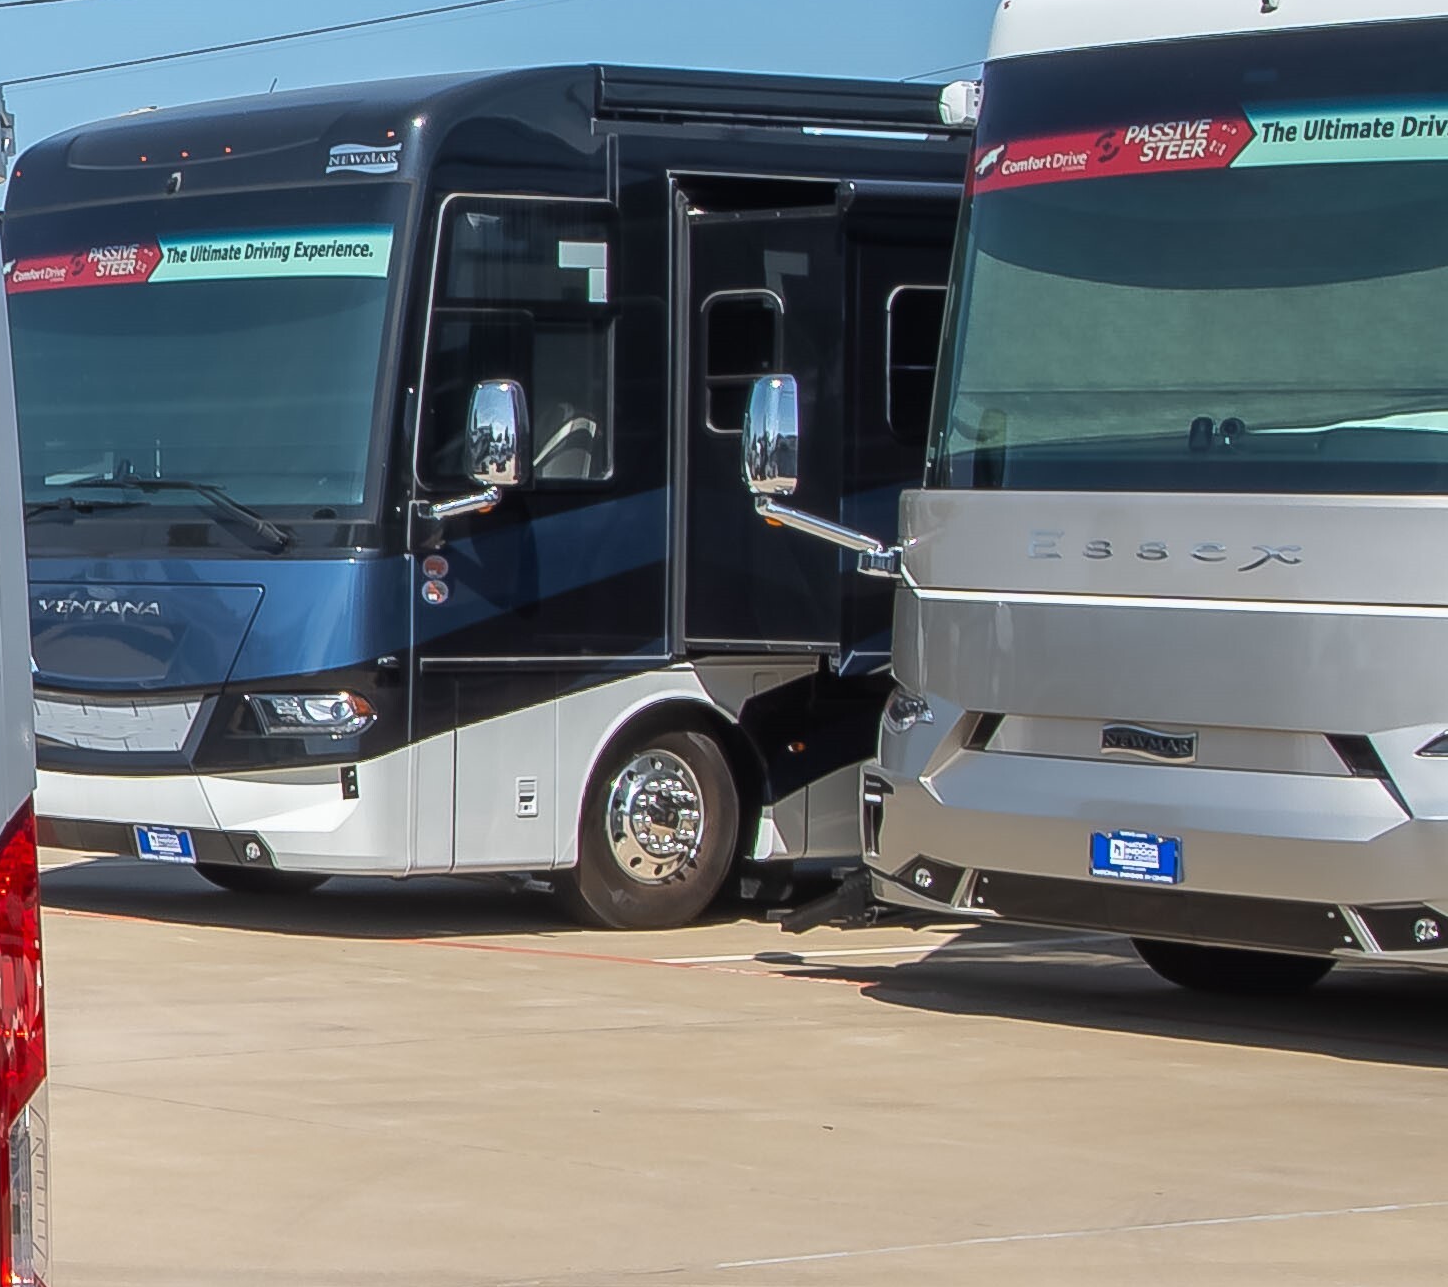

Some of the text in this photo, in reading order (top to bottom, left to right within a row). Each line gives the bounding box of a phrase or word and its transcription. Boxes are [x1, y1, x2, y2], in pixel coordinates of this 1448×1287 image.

[1124, 118, 1213, 145] PASSIVE
[1261, 114, 1448, 144] The Ultimate Driv
[329, 152, 397, 166] NEWMAR
[1139, 138, 1207, 163] STEER
[1001, 151, 1088, 176] Comfort Drive
[88, 244, 139, 263] PASSIVE
[166, 241, 374, 263] The Ultimate Driving Experience.
[13, 265, 67, 282] Comfort Drive
[96, 260, 137, 277] STEER
[38, 599, 161, 616] VENTANA
[1105, 734, 1191, 754] NEWMAR
